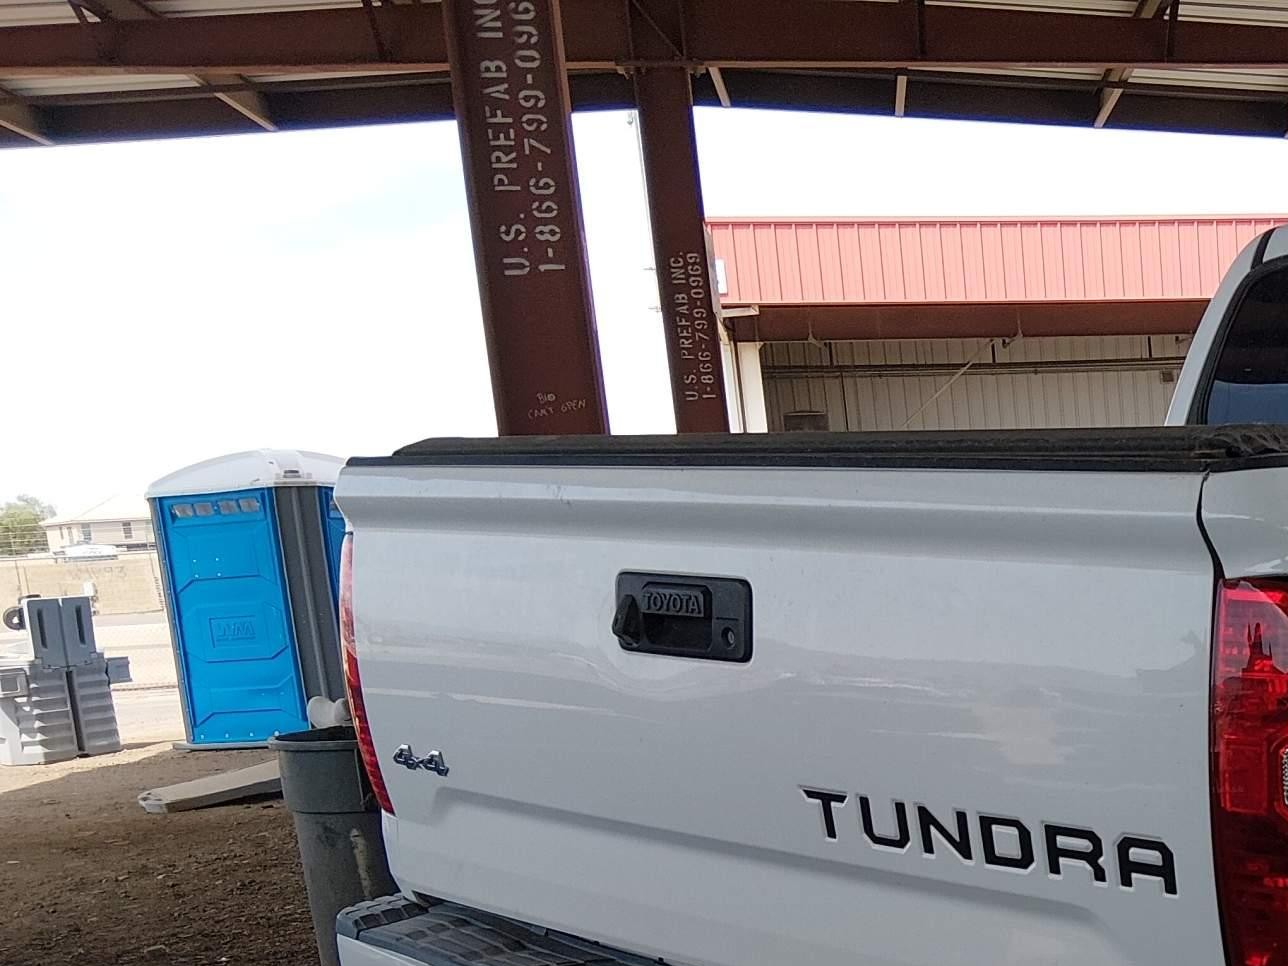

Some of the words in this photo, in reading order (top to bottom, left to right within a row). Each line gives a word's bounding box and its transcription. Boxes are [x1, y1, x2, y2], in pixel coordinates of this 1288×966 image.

[479, 60, 521, 191] PREFAB
[499, 213, 530, 275] U.S.
[670, 251, 687, 284] INC.
[674, 293, 695, 359] PREFAB
[686, 252, 717, 399] 1-866-799-0969
[684, 369, 699, 401] U.S.
[642, 590, 703, 615] TOYOTA
[799, 785, 1178, 897] TUNDRA
